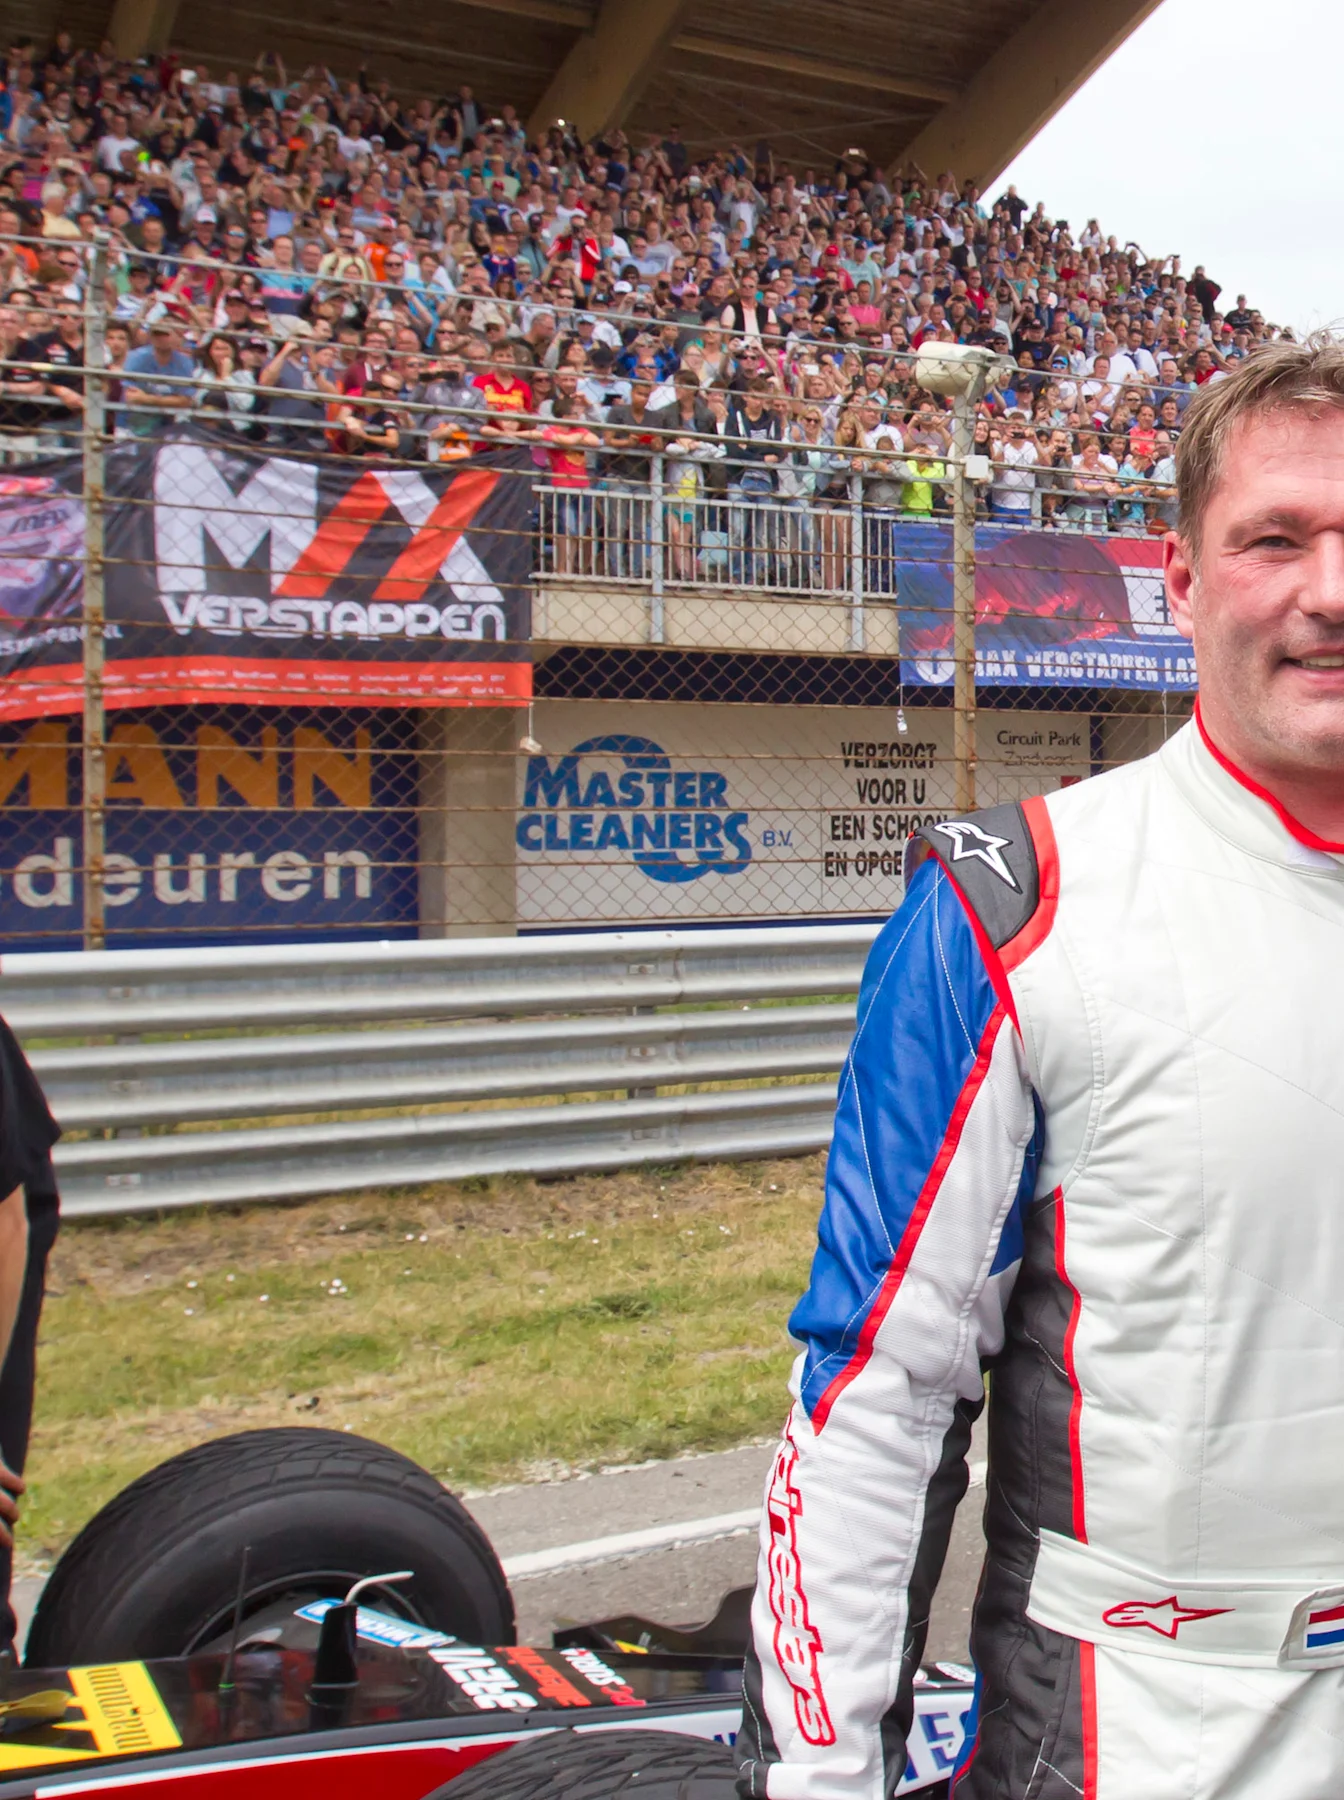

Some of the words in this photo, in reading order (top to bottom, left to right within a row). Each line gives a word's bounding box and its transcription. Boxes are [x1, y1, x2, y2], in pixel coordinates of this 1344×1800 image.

[155, 444, 505, 602] MAX
[159, 594, 507, 641] VERSTAPPEN
[1026, 650, 1159, 683] VERSTAPPEN
[996, 731, 1042, 746] Circuit
[1049, 731, 1081, 746] Park
[841, 742, 937, 769] VERZORGT
[523, 755, 729, 808] MASTER
[857, 778, 907, 804] VOOR
[914, 779, 926, 804] U
[515, 812, 752, 874] CLEANERS
[831, 815, 865, 841] EEN
[13, 837, 372, 907] deuren
[825, 851, 847, 876] EN
[855, 850, 903, 877] OPGE
